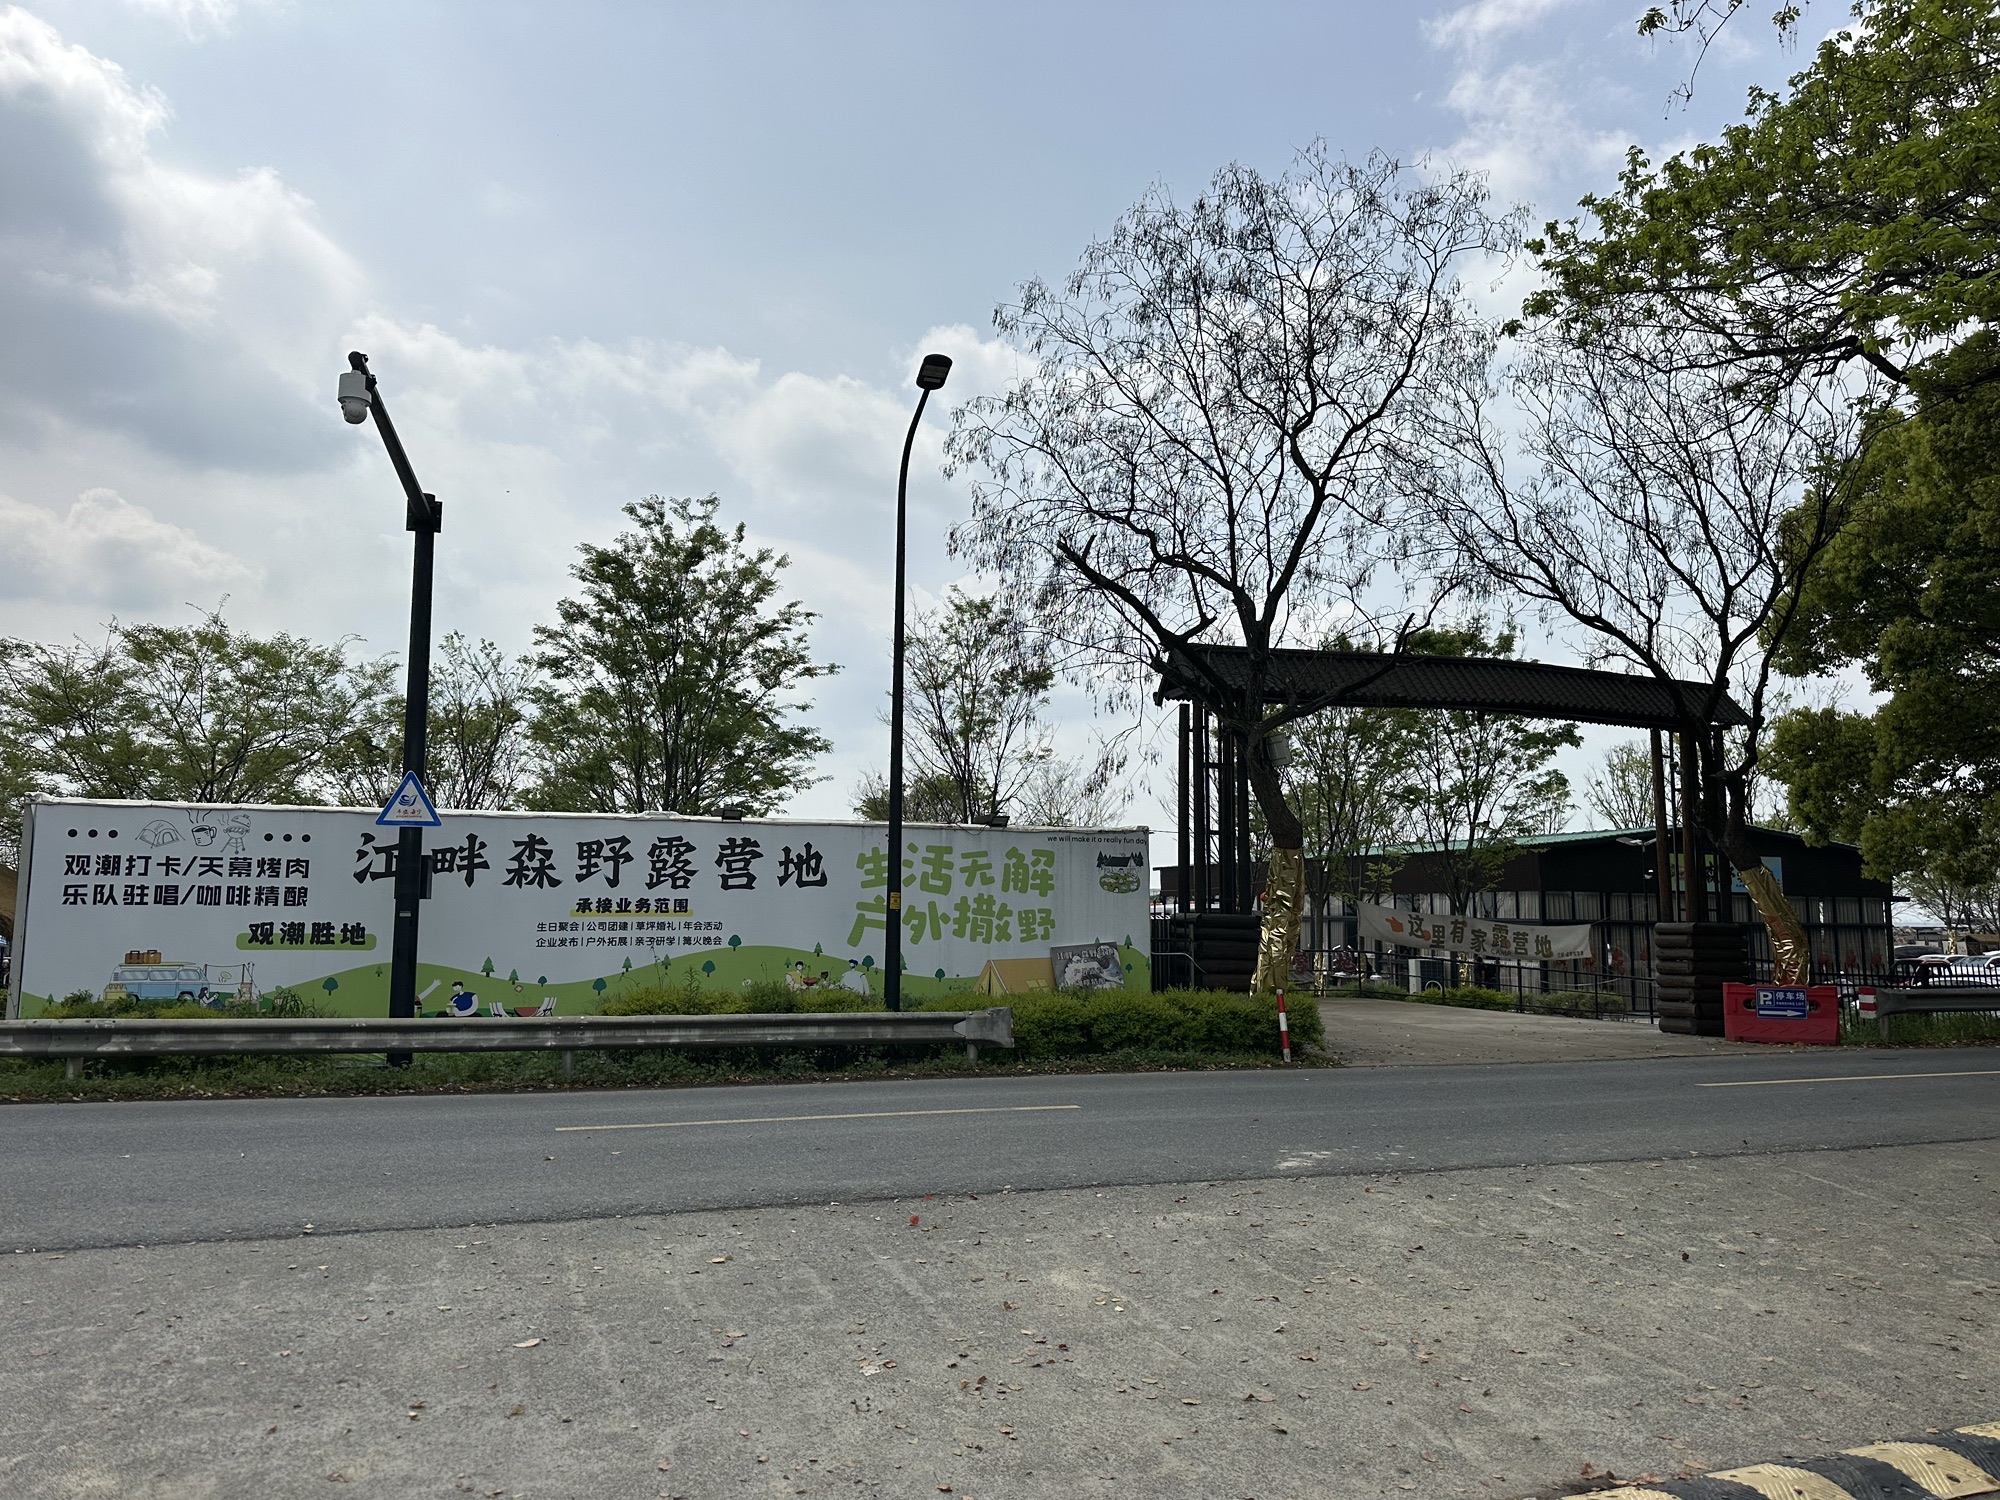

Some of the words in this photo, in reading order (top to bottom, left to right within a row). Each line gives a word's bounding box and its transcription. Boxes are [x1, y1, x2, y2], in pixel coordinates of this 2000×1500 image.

[1103, 836, 1121, 845] really
[1135, 837, 1147, 846] day
[62, 853, 310, 879] 观潮打卡/天幕烤肉
[353, 832, 828, 890] 江畔森野露营地
[856, 842, 1056, 897] 生活无解
[61, 883, 309, 907] 乐队驻唱/咖啡精酿
[575, 897, 690, 914] 承接业务范围
[847, 892, 1056, 947] 户外撒野
[247, 920, 367, 946] 观潮胜地
[1407, 913, 1554, 959] 这里有家露营地
[1759, 991, 1773, 1005] P
[1775, 991, 1805, 1001] 停车场
